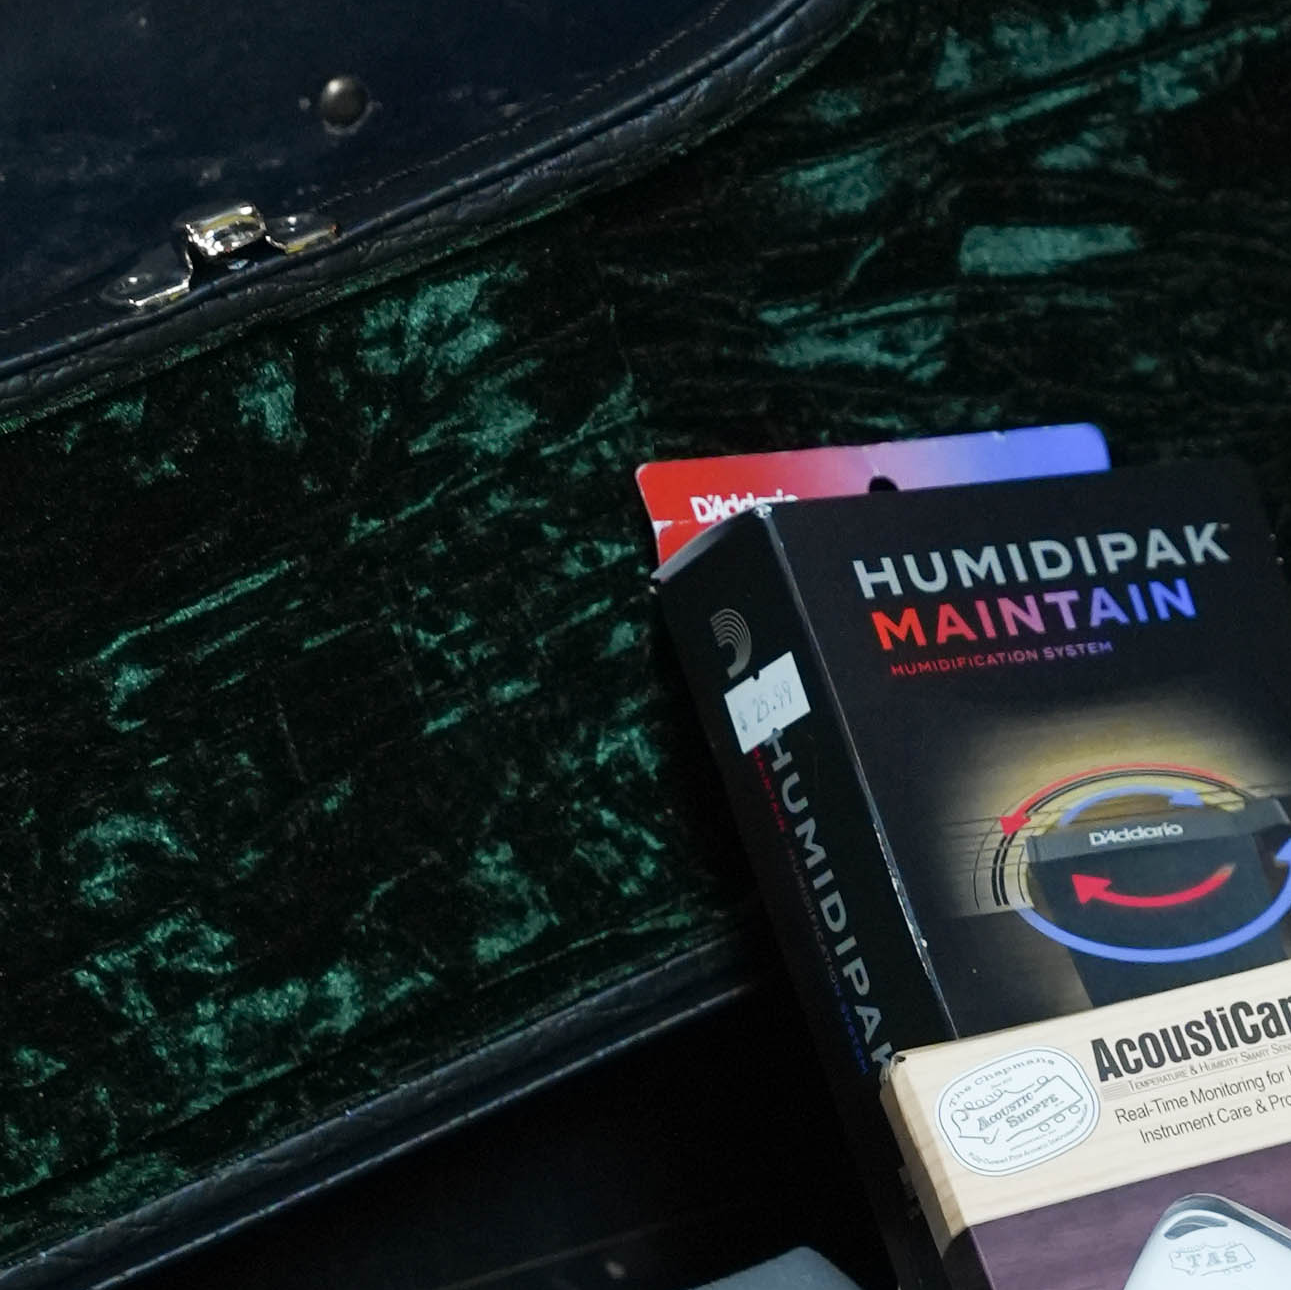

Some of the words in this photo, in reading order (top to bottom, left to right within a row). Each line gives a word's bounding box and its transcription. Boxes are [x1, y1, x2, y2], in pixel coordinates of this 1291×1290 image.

[853, 522, 1230, 599] HUMIDIPAK
[871, 578, 1197, 650] MAINTAIN
[891, 648, 1039, 677] HUMIDIFICATION
[1043, 640, 1114, 660] SYSTEM
[1089, 822, 1184, 846] D'Addario
[1115, 1093, 1189, 1124] Real-Time
[1190, 1075, 1266, 1105] Monitoring
[1266, 1068, 1285, 1085] for
[1140, 1111, 1219, 1144] Instrument
[1217, 1103, 1253, 1124] Care
[1256, 1099, 1267, 1114] &
